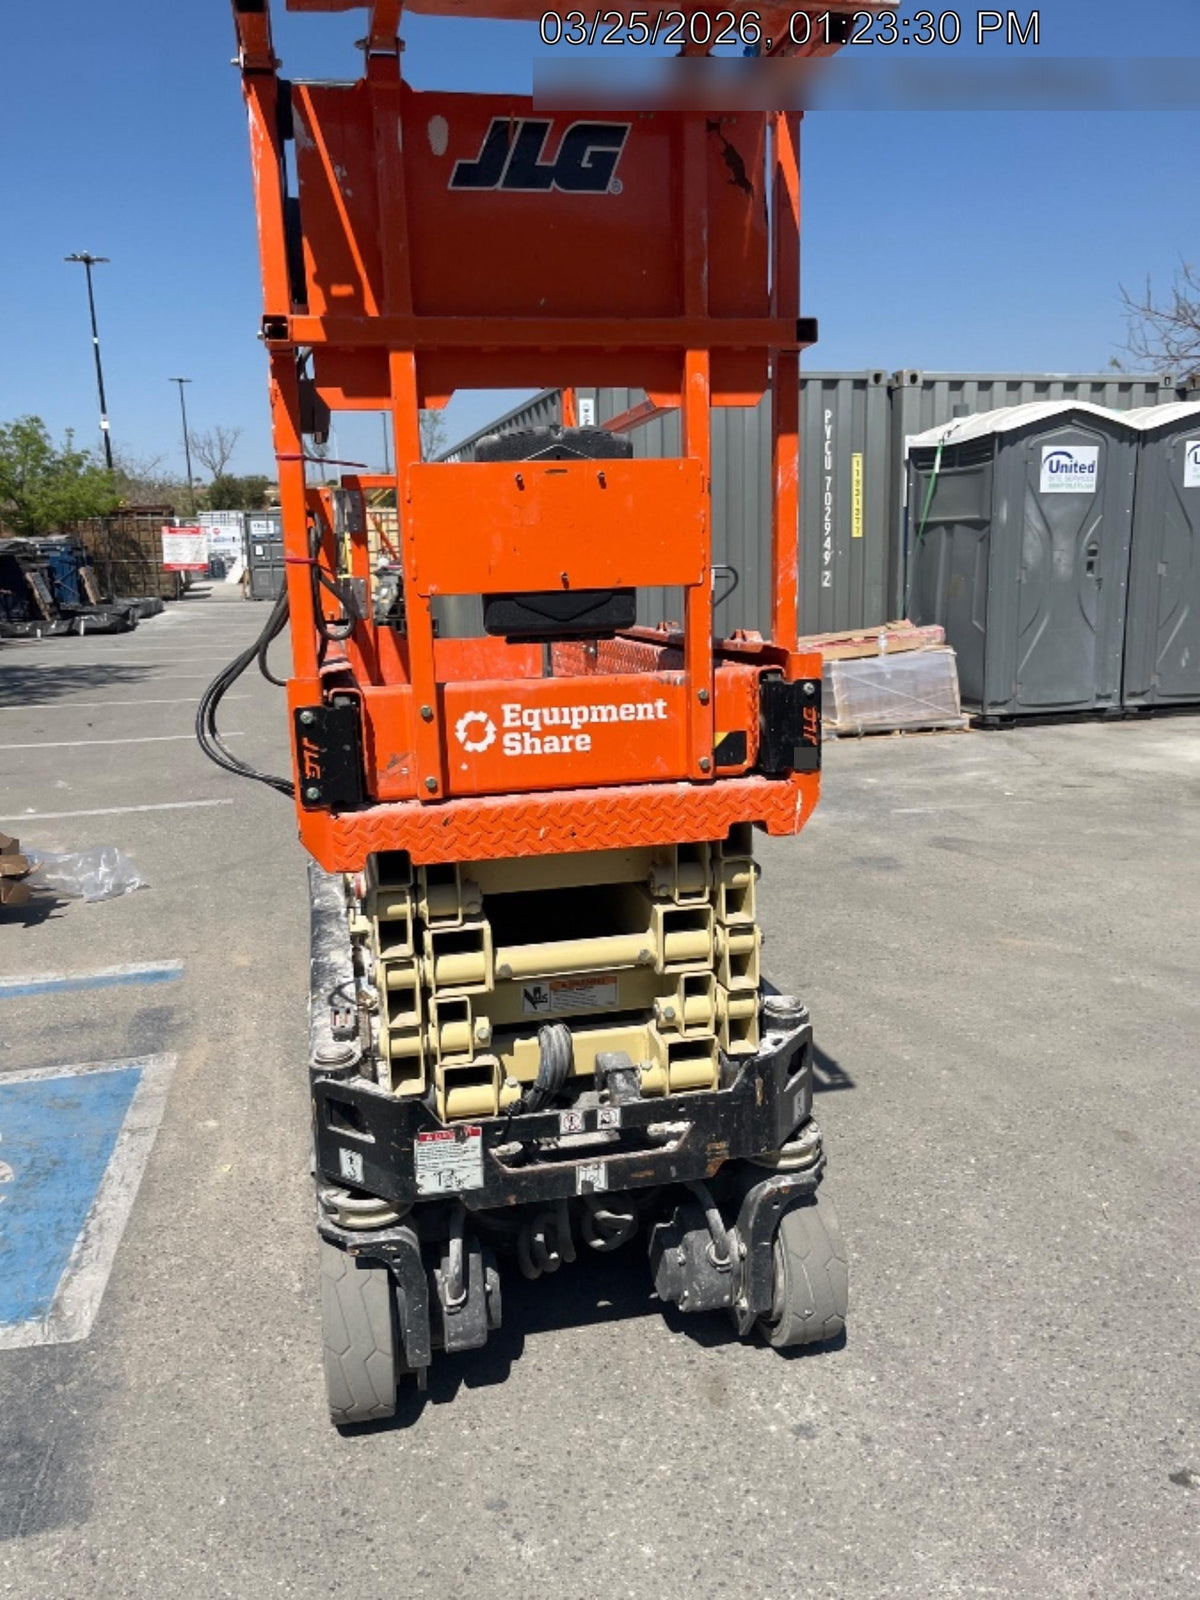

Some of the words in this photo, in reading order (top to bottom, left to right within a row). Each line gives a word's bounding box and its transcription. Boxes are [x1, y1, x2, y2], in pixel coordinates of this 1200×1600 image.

[447, 117, 633, 195] JLG
[1048, 459, 1096, 474] United
[501, 698, 668, 731] Equipment
[502, 731, 591, 756] Share
